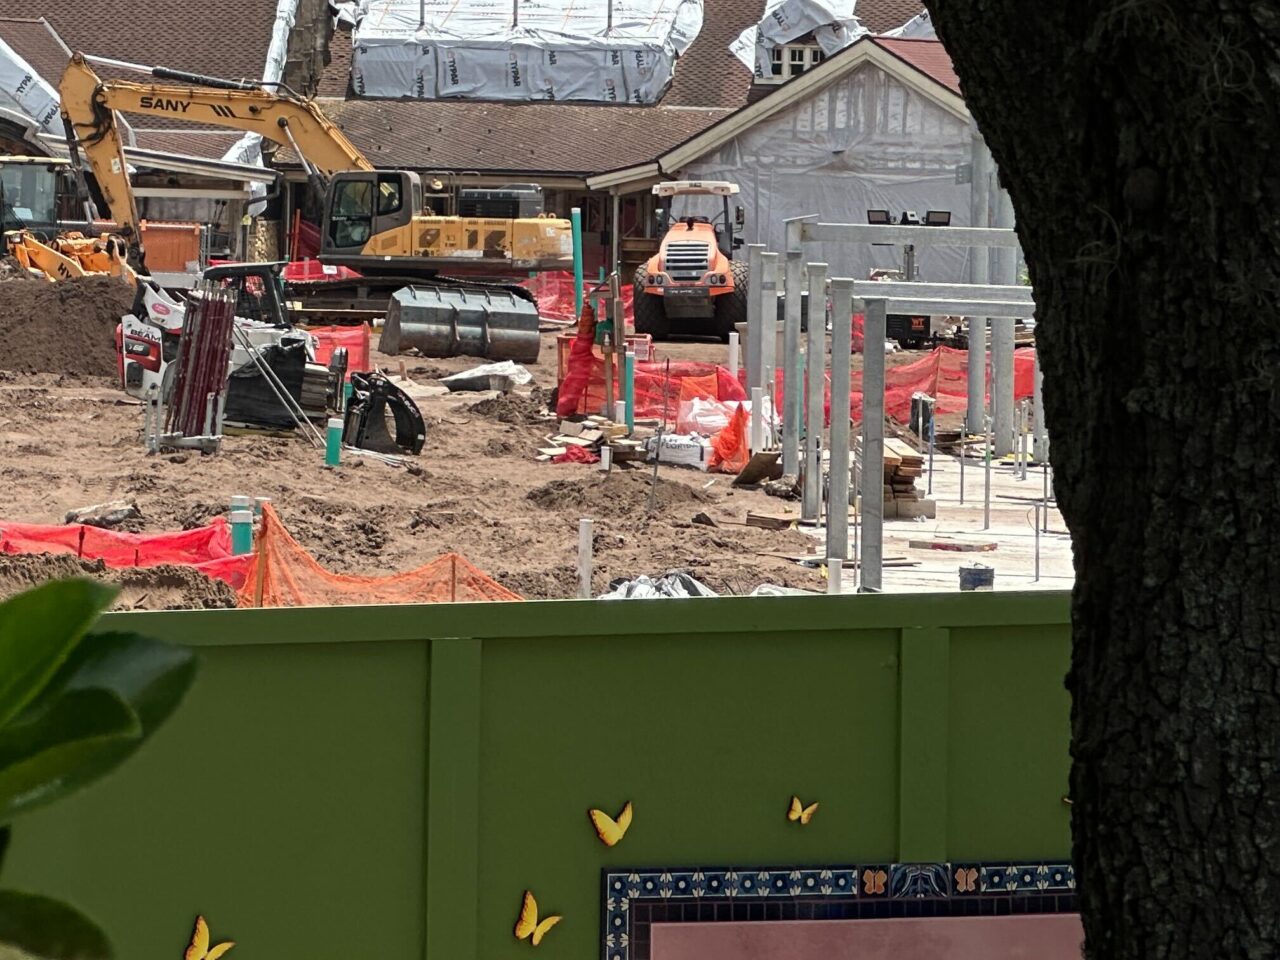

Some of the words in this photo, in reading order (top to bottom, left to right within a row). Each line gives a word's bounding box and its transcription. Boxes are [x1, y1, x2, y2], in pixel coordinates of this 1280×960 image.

[449, 57, 459, 86] TYPAR
[509, 60, 521, 87] TYPAR
[140, 96, 191, 113] SANY
